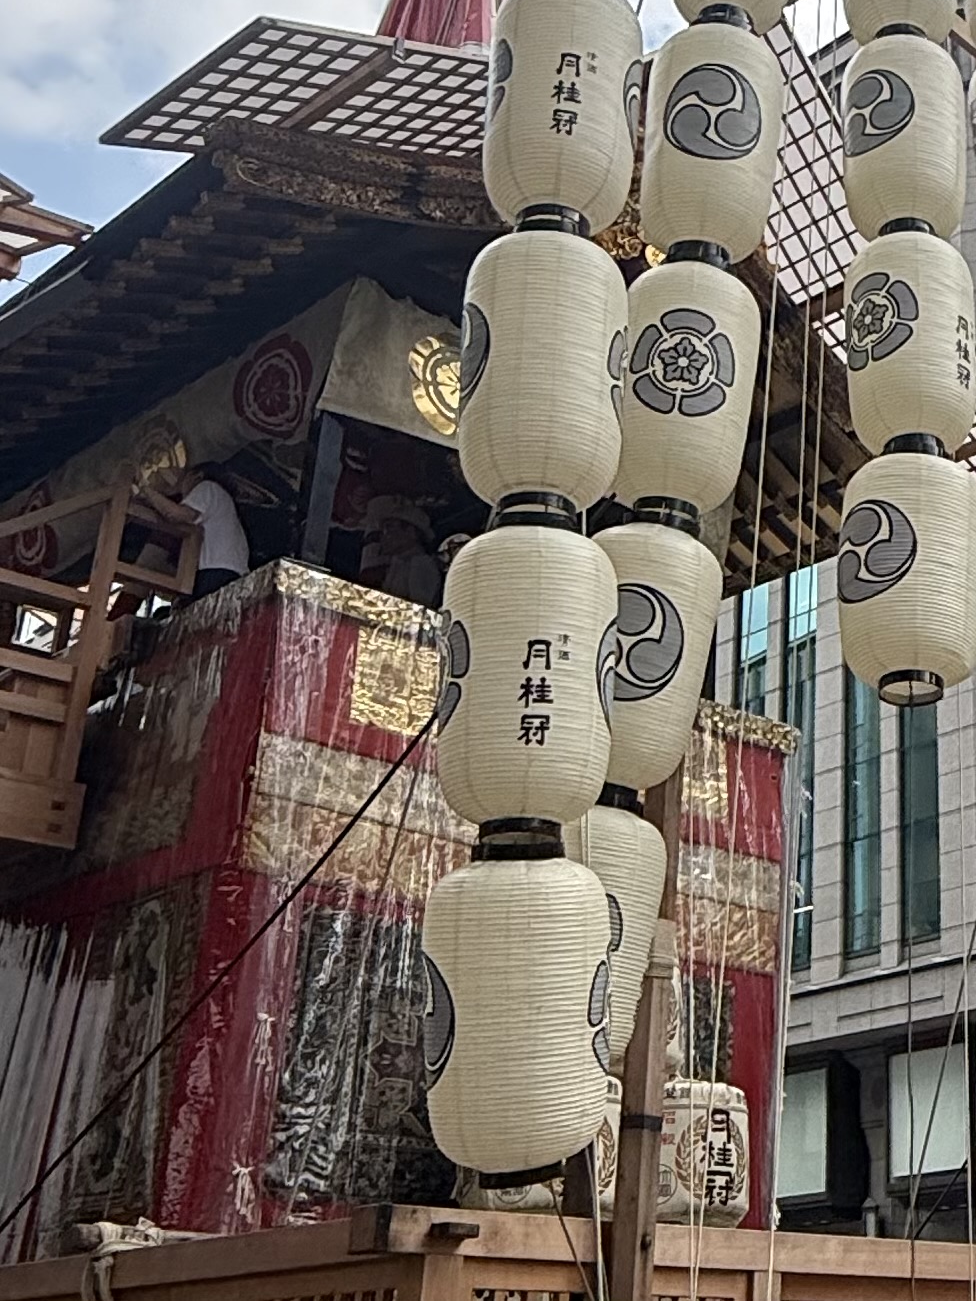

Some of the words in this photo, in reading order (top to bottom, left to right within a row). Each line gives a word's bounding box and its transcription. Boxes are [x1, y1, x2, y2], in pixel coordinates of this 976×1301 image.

[549, 53, 582, 136] 月桂冠
[955, 315, 971, 390] 月桂冠
[517, 639, 553, 746] 月桂冠
[700, 1108, 734, 1206] 月桂冠
